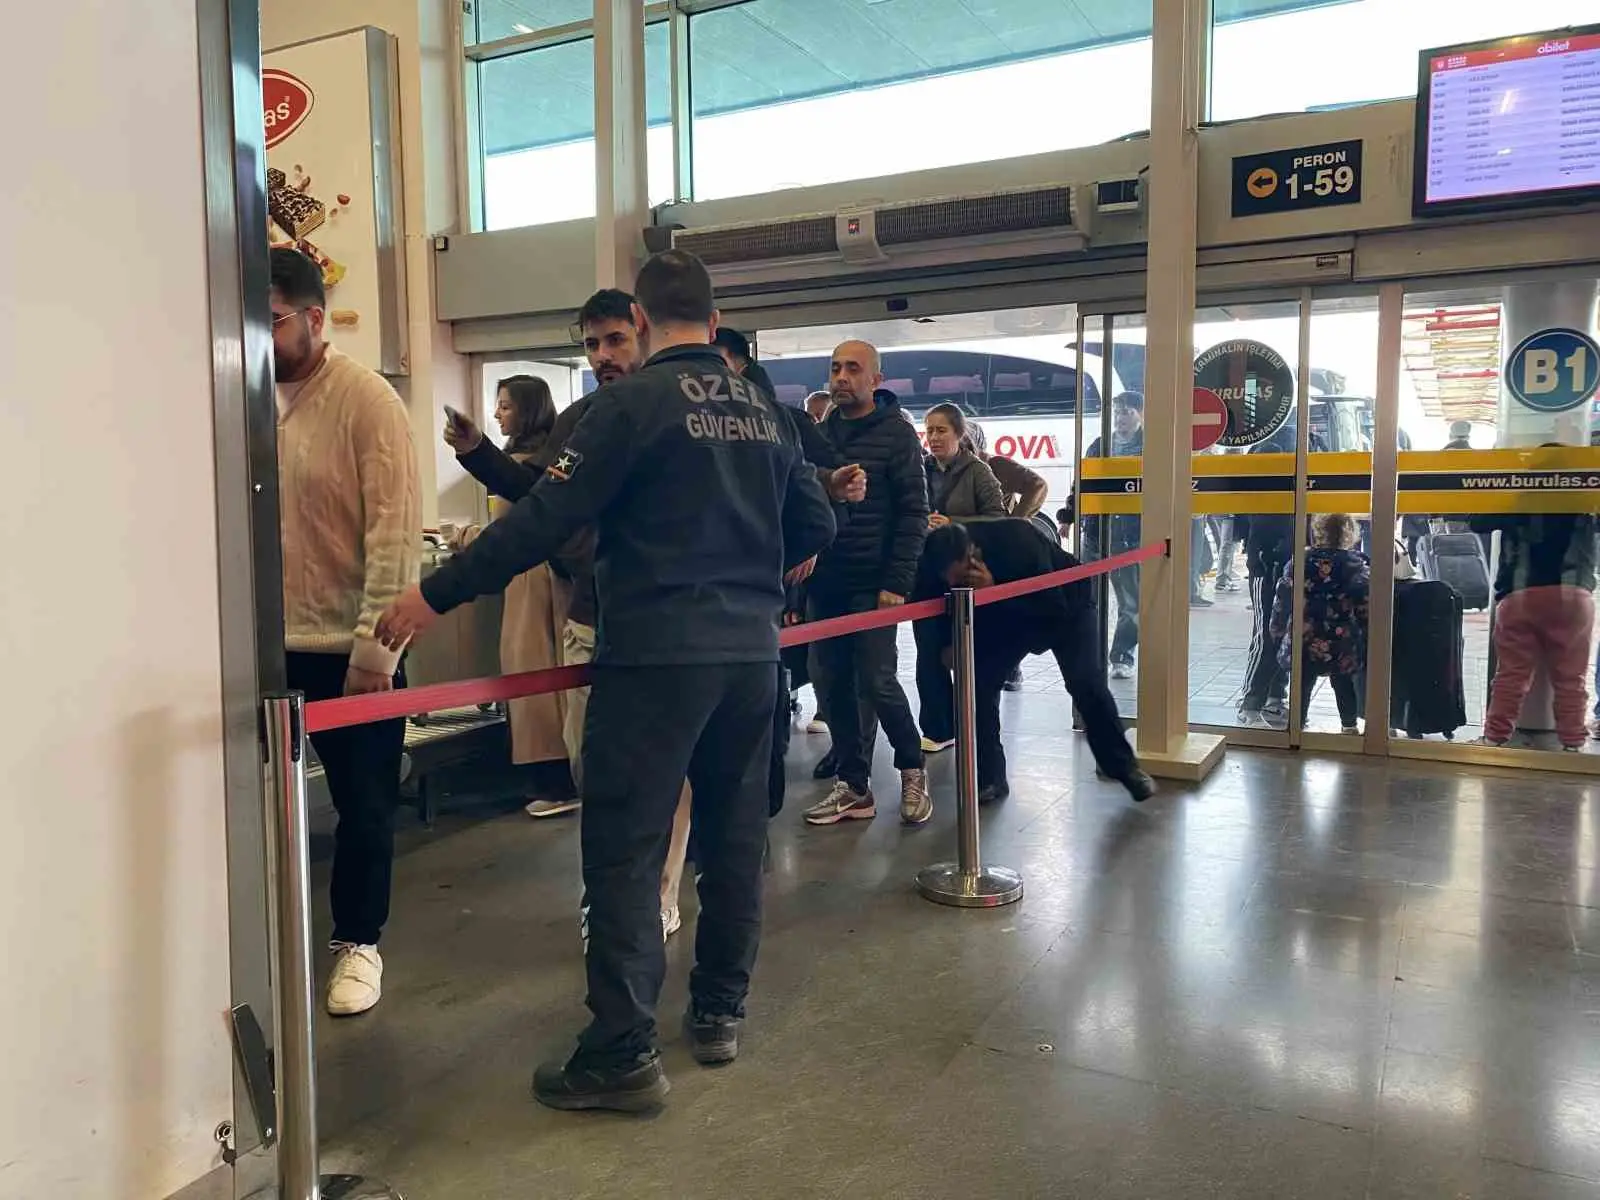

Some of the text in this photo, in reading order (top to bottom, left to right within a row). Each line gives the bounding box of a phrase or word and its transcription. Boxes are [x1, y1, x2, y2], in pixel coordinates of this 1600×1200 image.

[1293, 151, 1346, 169] PERON
[1285, 166, 1354, 200] 1-59
[1194, 342, 1244, 376] ERMİNALİN
[1524, 347, 1587, 394] B1
[677, 373, 769, 412] ÖZEL
[686, 409, 782, 445] GÜVENLİK
[1461, 473, 1600, 488] www.burulas.c
